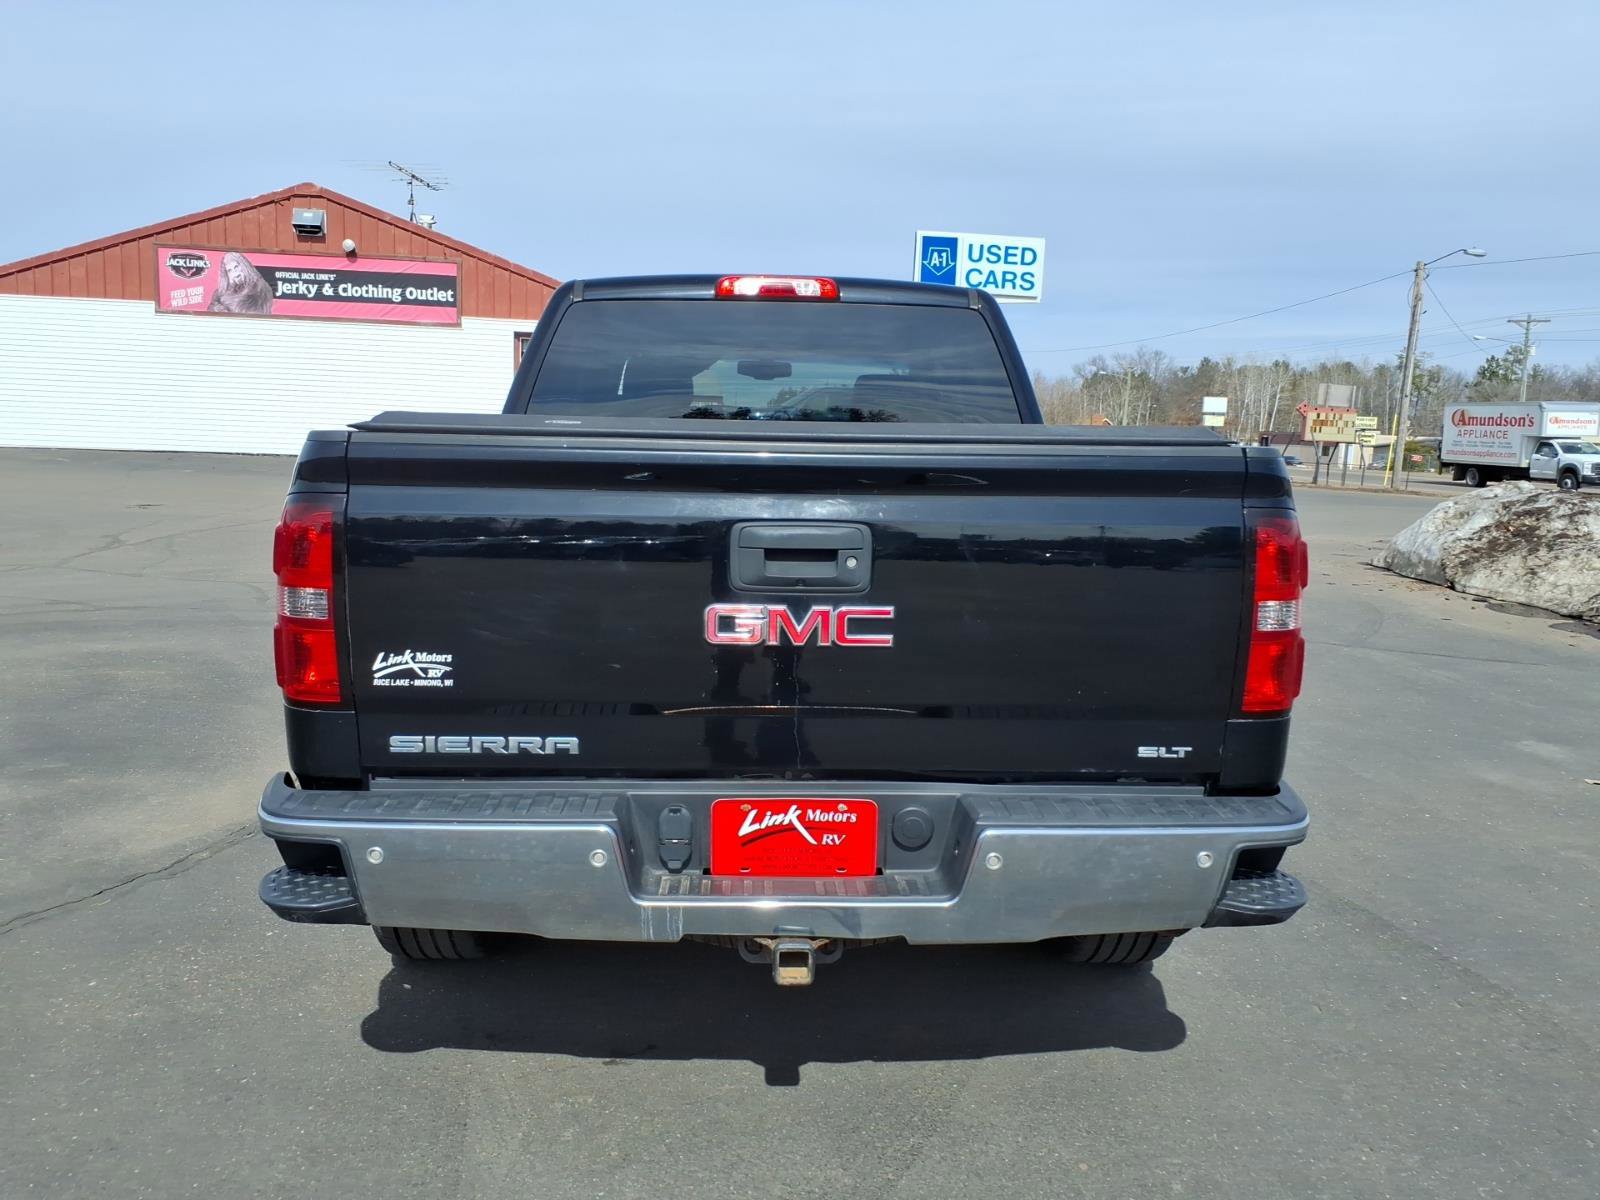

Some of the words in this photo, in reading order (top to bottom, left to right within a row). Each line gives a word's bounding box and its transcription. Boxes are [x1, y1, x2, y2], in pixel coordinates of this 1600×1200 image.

[930, 252, 947, 267] A-1
[967, 243, 1037, 266] USED
[166, 257, 186, 267] JACK
[275, 271, 300, 279] OFFICIAL
[301, 272, 315, 280] JACK
[965, 268, 1035, 291] CARS
[170, 289, 186, 299] FEED
[187, 286, 204, 296] YOUR
[275, 280, 317, 298] Jerky
[322, 283, 334, 296] &
[338, 284, 402, 302] Clothing
[405, 287, 454, 302] Outlet
[171, 297, 188, 307] WILD
[188, 295, 203, 304] SIDE
[1452, 408, 1535, 428] Amundson's
[1456, 429, 1509, 440] APPLIANCE
[703, 603, 895, 648] GMC
[372, 649, 425, 677] Link
[415, 652, 452, 663] Motors
[427, 669, 445, 677] RV
[373, 679, 390, 687] RICE
[391, 679, 410, 687] LAKE
[414, 679, 443, 688] MINONG,
[444, 679, 454, 687] WI
[389, 735, 580, 755] SIERRA
[1137, 746, 1193, 759] SLT
[737, 805, 818, 845] Link
[806, 808, 858, 824] Motors
[821, 834, 846, 846] RV
